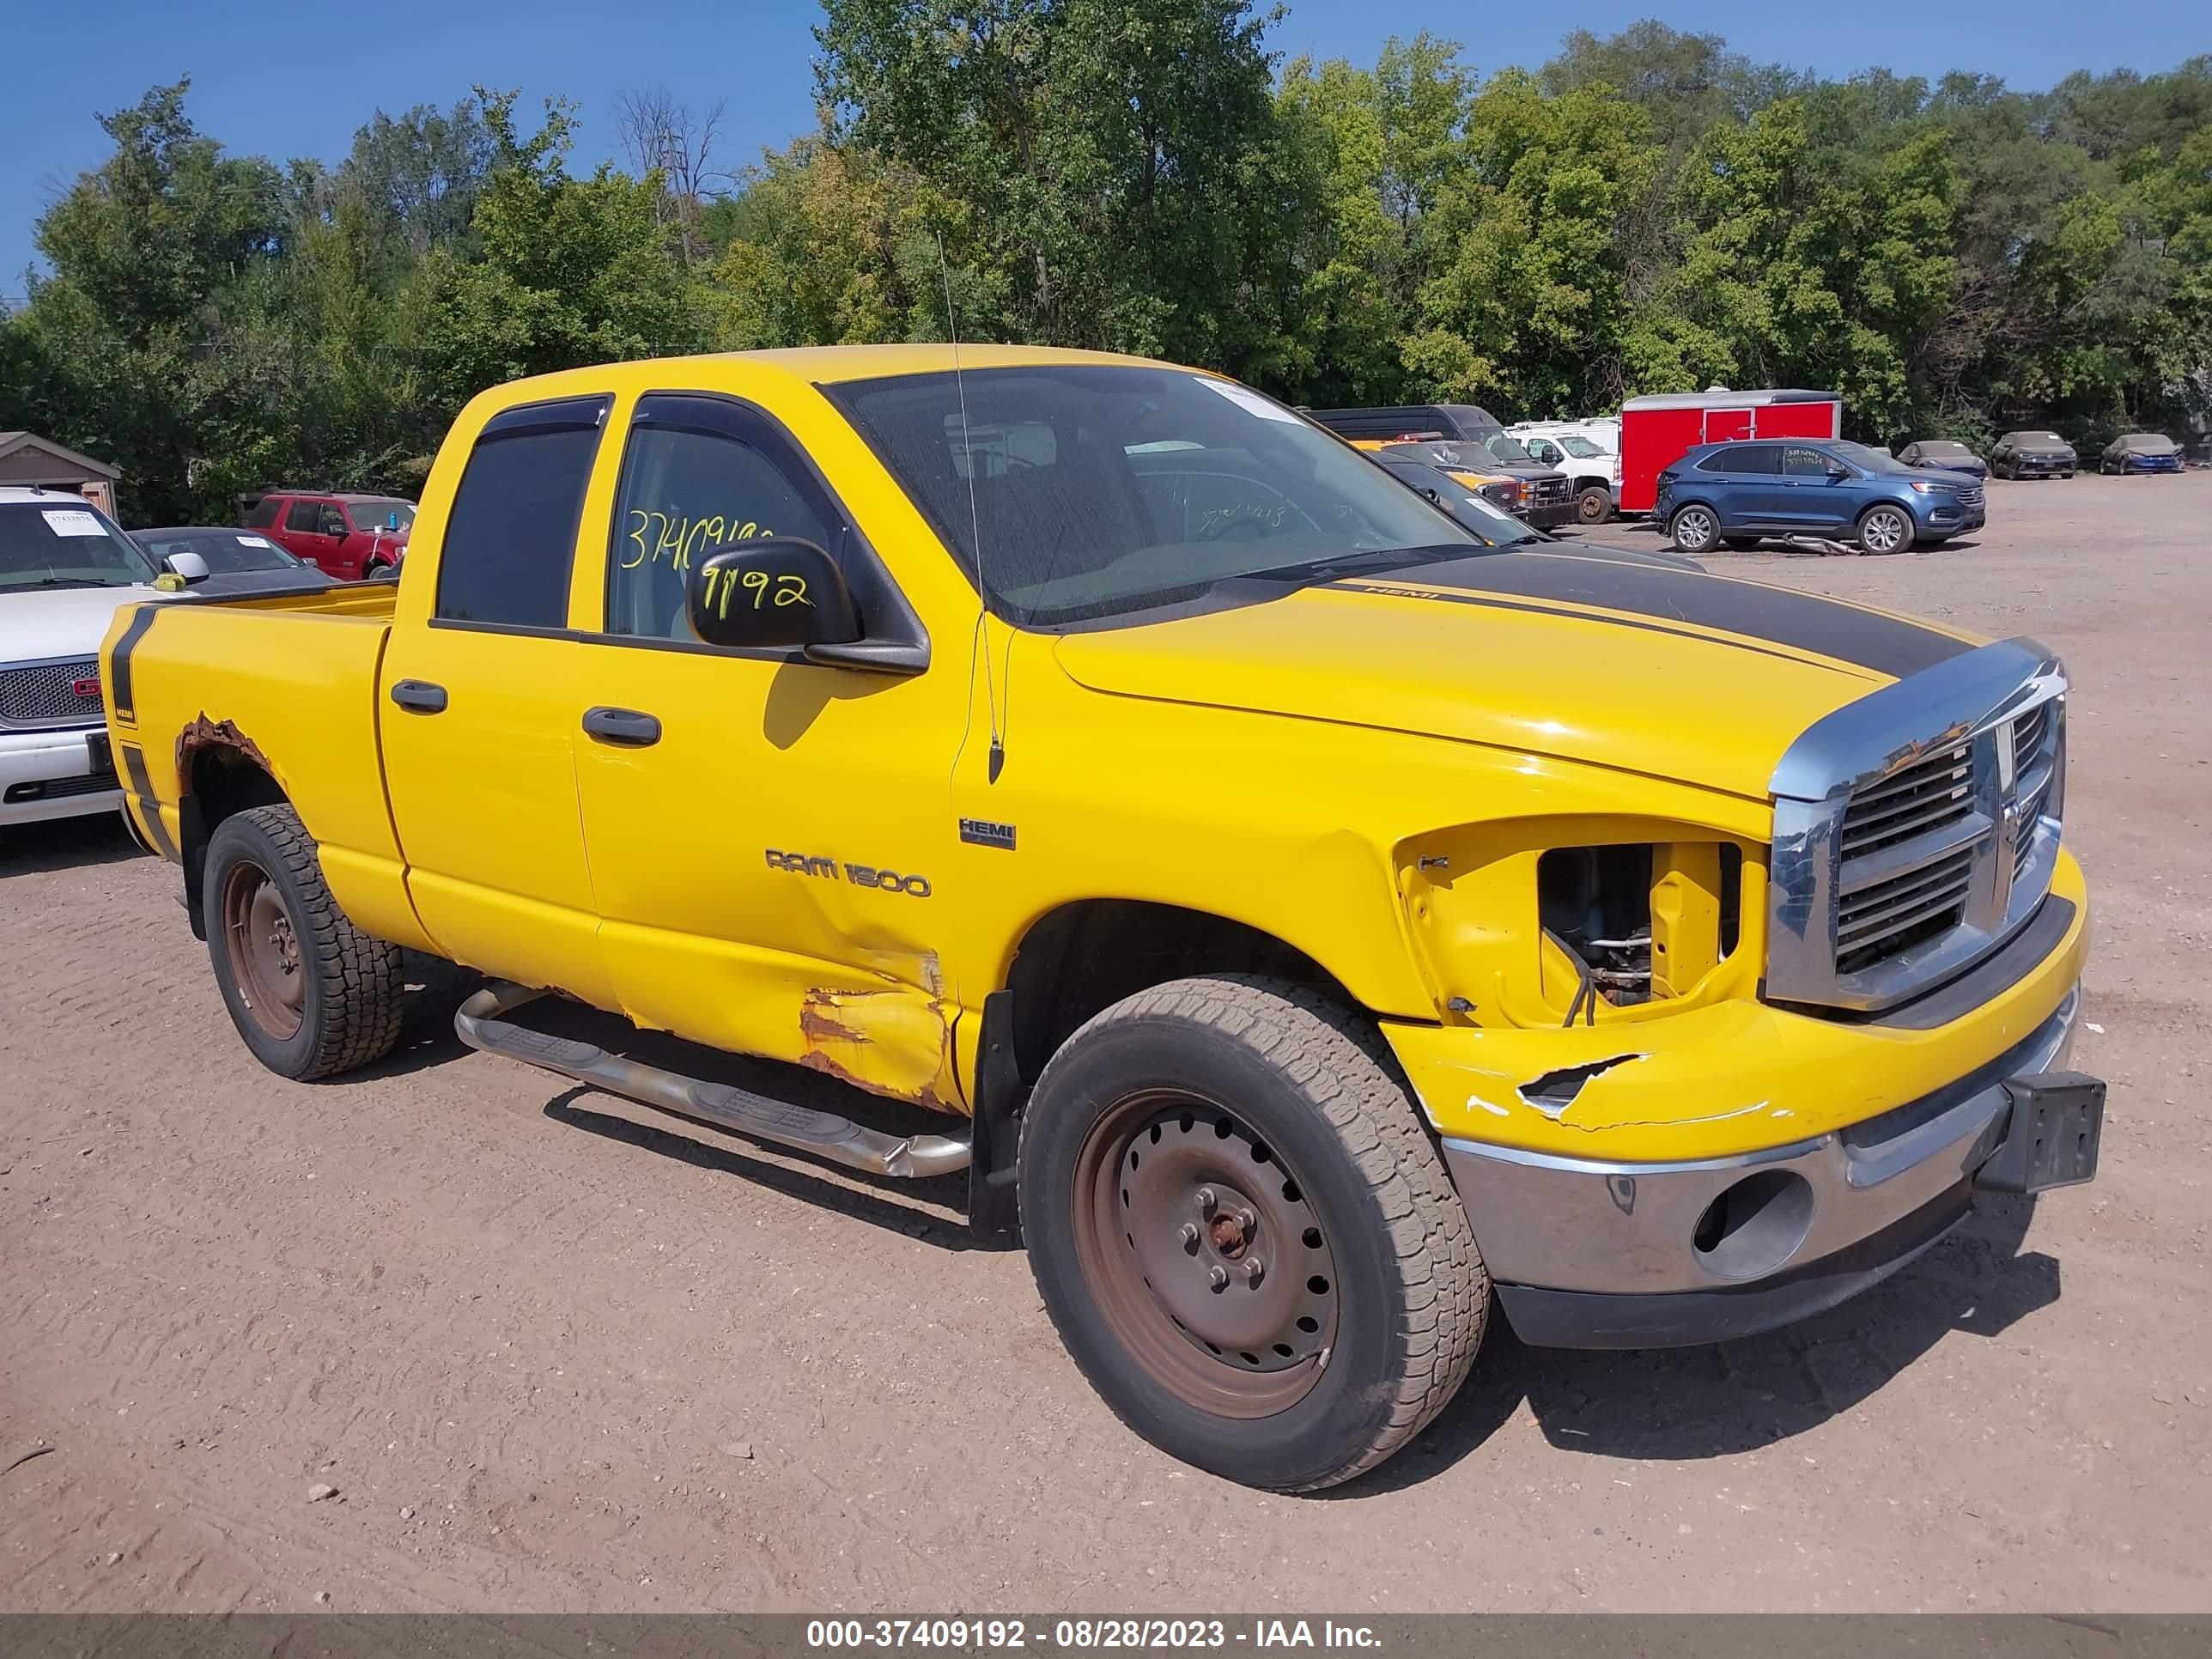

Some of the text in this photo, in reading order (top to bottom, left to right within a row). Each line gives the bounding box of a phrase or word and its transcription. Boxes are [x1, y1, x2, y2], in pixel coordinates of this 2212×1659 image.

[1364, 587, 1440, 599] HEMI
[116, 708, 133, 719] HEMI
[959, 817, 1015, 839] HEMI
[765, 848, 932, 897] RAM 1500
